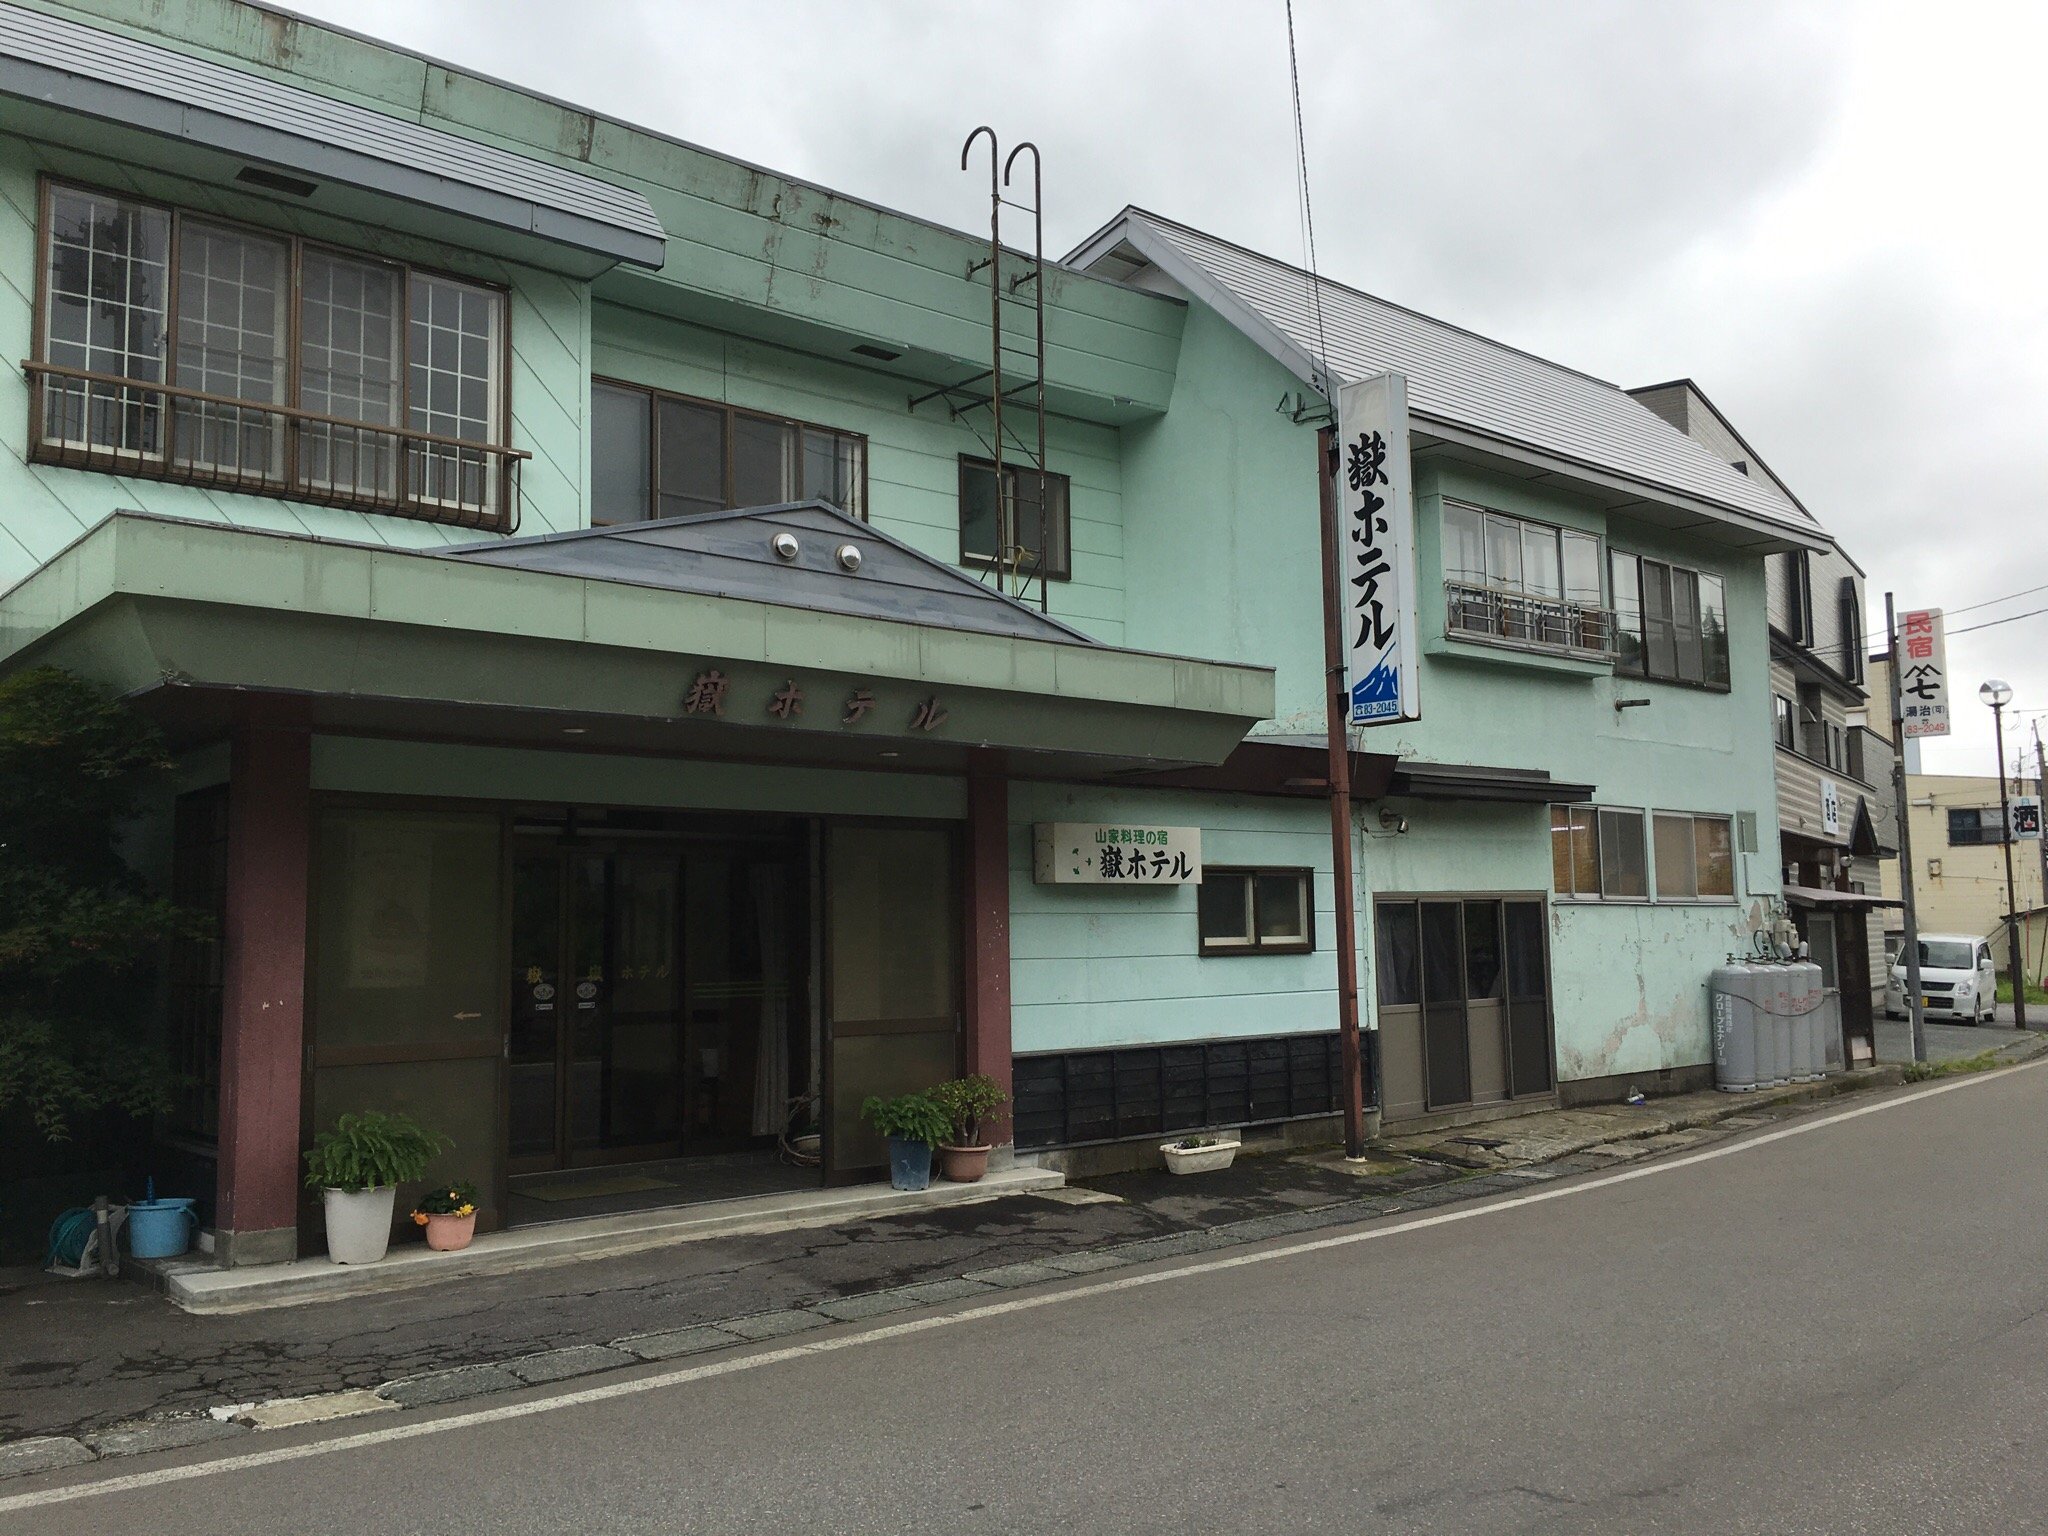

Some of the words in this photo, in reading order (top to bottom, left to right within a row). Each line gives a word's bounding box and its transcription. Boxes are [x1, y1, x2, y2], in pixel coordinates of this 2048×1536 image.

[1348, 430, 1395, 651] 嶽ホテル
[1905, 611, 1933, 660] 民宿
[1363, 700, 1398, 715] 83-2045
[1906, 722, 1946, 734] 83-2049
[2012, 804, 2040, 833] 酒
[1095, 827, 1168, 846] 山家料理の宿
[1100, 844, 1194, 880] 嶽ホテル
